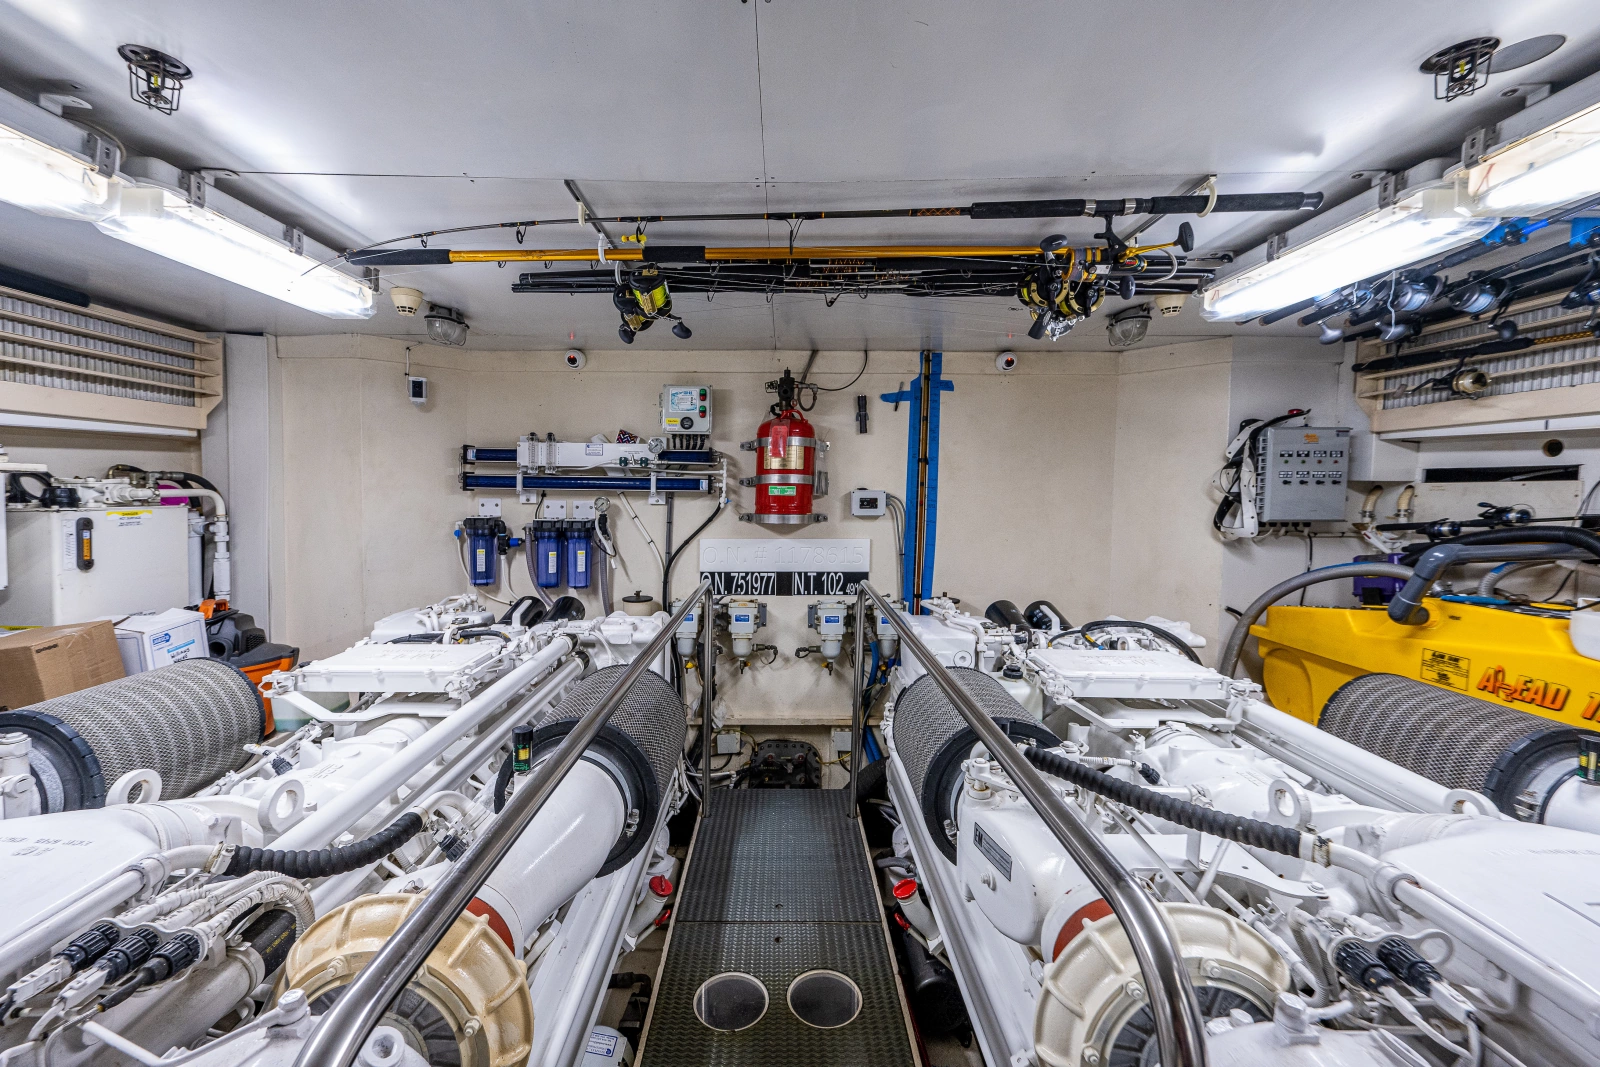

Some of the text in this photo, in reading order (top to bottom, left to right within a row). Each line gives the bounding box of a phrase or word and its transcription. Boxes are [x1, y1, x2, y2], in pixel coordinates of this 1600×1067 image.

[703, 546, 863, 565] O.N. # 1178615
[730, 572, 775, 595] 751977
[794, 572, 818, 595] N.T.
[821, 572, 844, 595] 102
